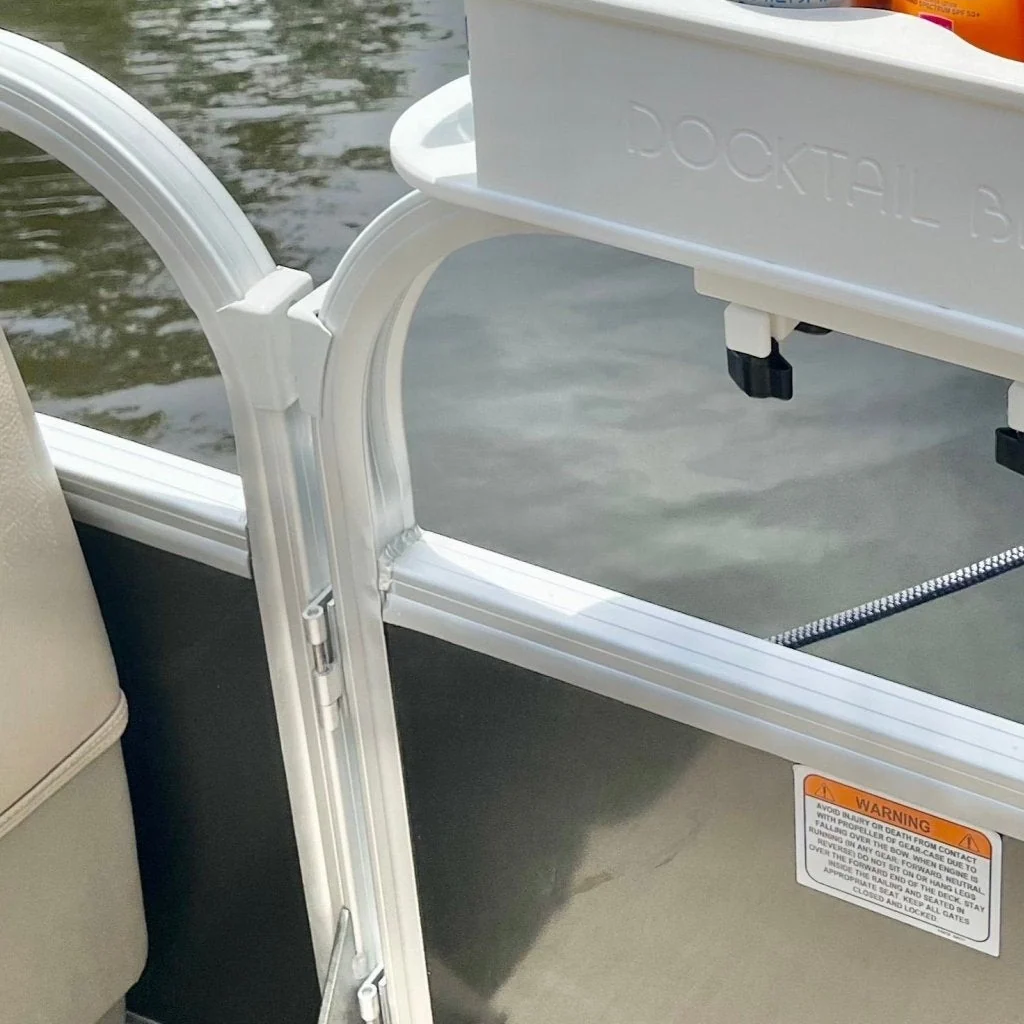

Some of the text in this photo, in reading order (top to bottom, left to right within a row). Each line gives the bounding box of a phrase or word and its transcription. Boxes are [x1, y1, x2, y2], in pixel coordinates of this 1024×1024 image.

[625, 100, 940, 228] DOCKTAIL
[808, 826, 842, 844] RUNNING
[856, 843, 873, 855] ANY
[816, 801, 976, 865] AVOID INJURY OR DEATH FROM CONTACT
[816, 811, 836, 824] WITH
[837, 818, 883, 841] PROPELLER
[886, 835, 896, 845] OF
[947, 857, 964, 870] DUE
[966, 864, 976, 874] TO
[856, 796, 931, 833] WARNING
[808, 843, 829, 857] OVER
[832, 851, 846, 863] THE
[848, 857, 887, 877] FORWARD
[889, 872, 905, 884] END
[907, 878, 918, 888] OF
[920, 883, 935, 895] THE
[964, 899, 984, 912] STAY
[815, 819, 847, 837] FALLING
[849, 831, 870, 845] OVER
[873, 840, 888, 851] THE
[912, 854, 936, 869] WHEN
[938, 863, 968, 880] ENGINE
[970, 875, 978, 884] IS
[857, 852, 868, 862] DO
[870, 857, 886, 868] NOT
[888, 863, 900, 874] SIT
[902, 868, 914, 879] ON
[916, 873, 927, 883] OR
[929, 878, 952, 892] HANG
[954, 887, 976, 901] LEGS
[823, 866, 876, 891] APPROPRIATE
[903, 894, 924, 908] KEEP
[925, 902, 940, 914] ALL
[942, 908, 969, 924] GATES
[828, 859, 964, 914] INSIDE THE RAILING AND SEATED IN
[852, 885, 883, 903] CLOSED
[886, 897, 902, 909] AND
